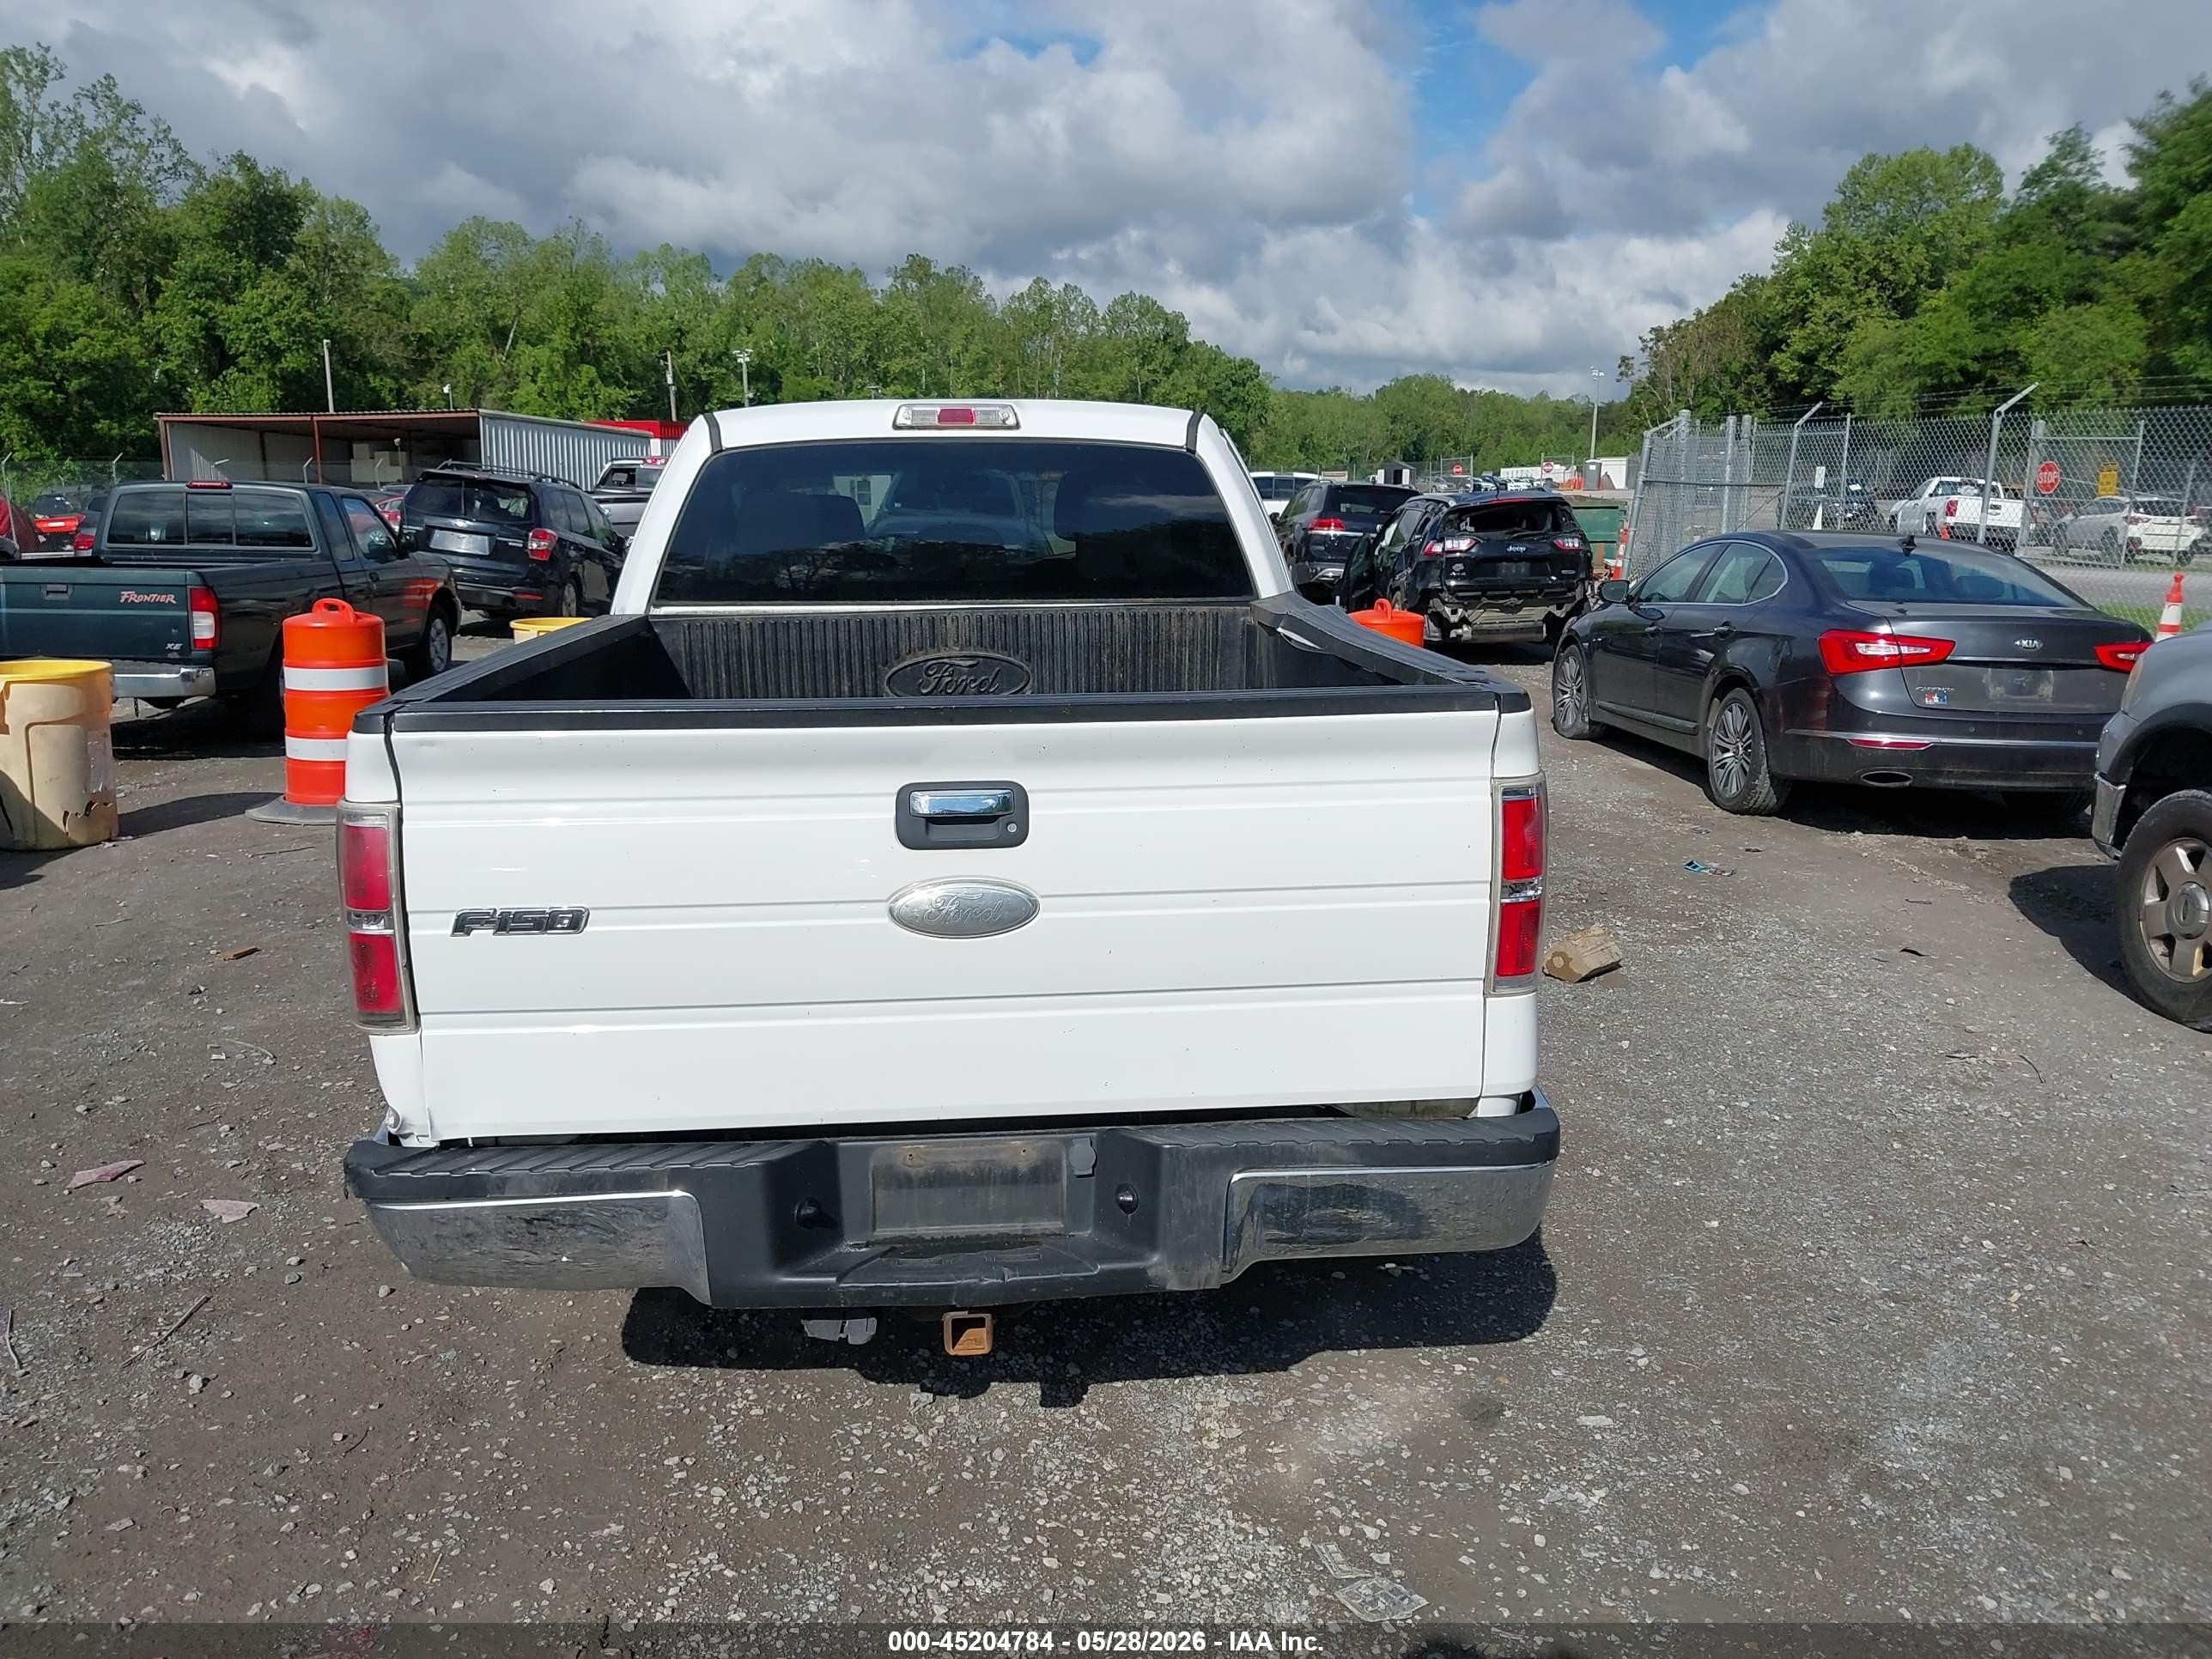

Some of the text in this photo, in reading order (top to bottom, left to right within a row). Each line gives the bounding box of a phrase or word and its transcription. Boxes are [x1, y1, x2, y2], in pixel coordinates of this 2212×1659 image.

[2039, 471, 2058, 483] STOP
[1506, 544, 1527, 554] Jeep
[119, 590, 177, 605] FRONTIER
[2021, 639, 2039, 648] KIA
[918, 658, 1002, 696] Ford
[923, 892, 1003, 924] Ford
[450, 906, 590, 937] F-150
